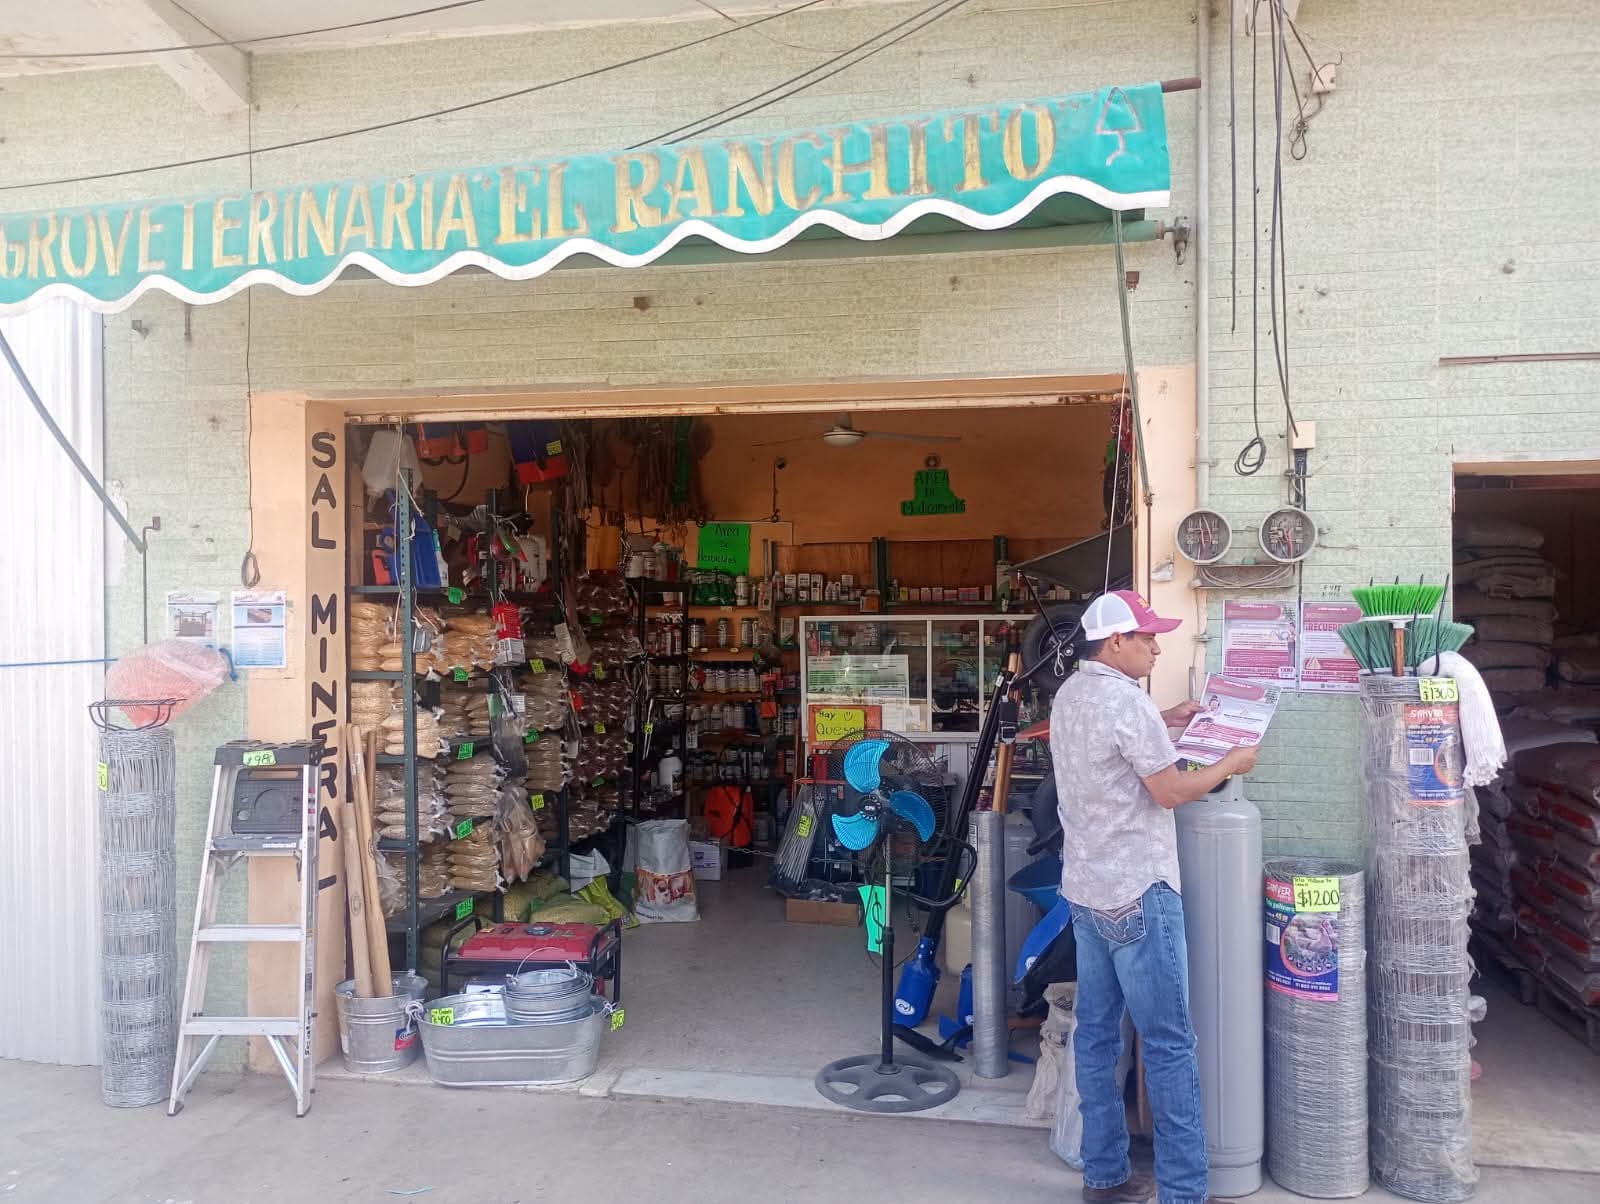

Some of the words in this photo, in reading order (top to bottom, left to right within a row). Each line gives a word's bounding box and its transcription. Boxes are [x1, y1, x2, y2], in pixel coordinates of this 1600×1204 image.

[311, 431, 337, 550] SAL
[311, 593, 337, 890] MINERA
[818, 710, 836, 721] Hay
[1296, 888, 1340, 908] $1200
